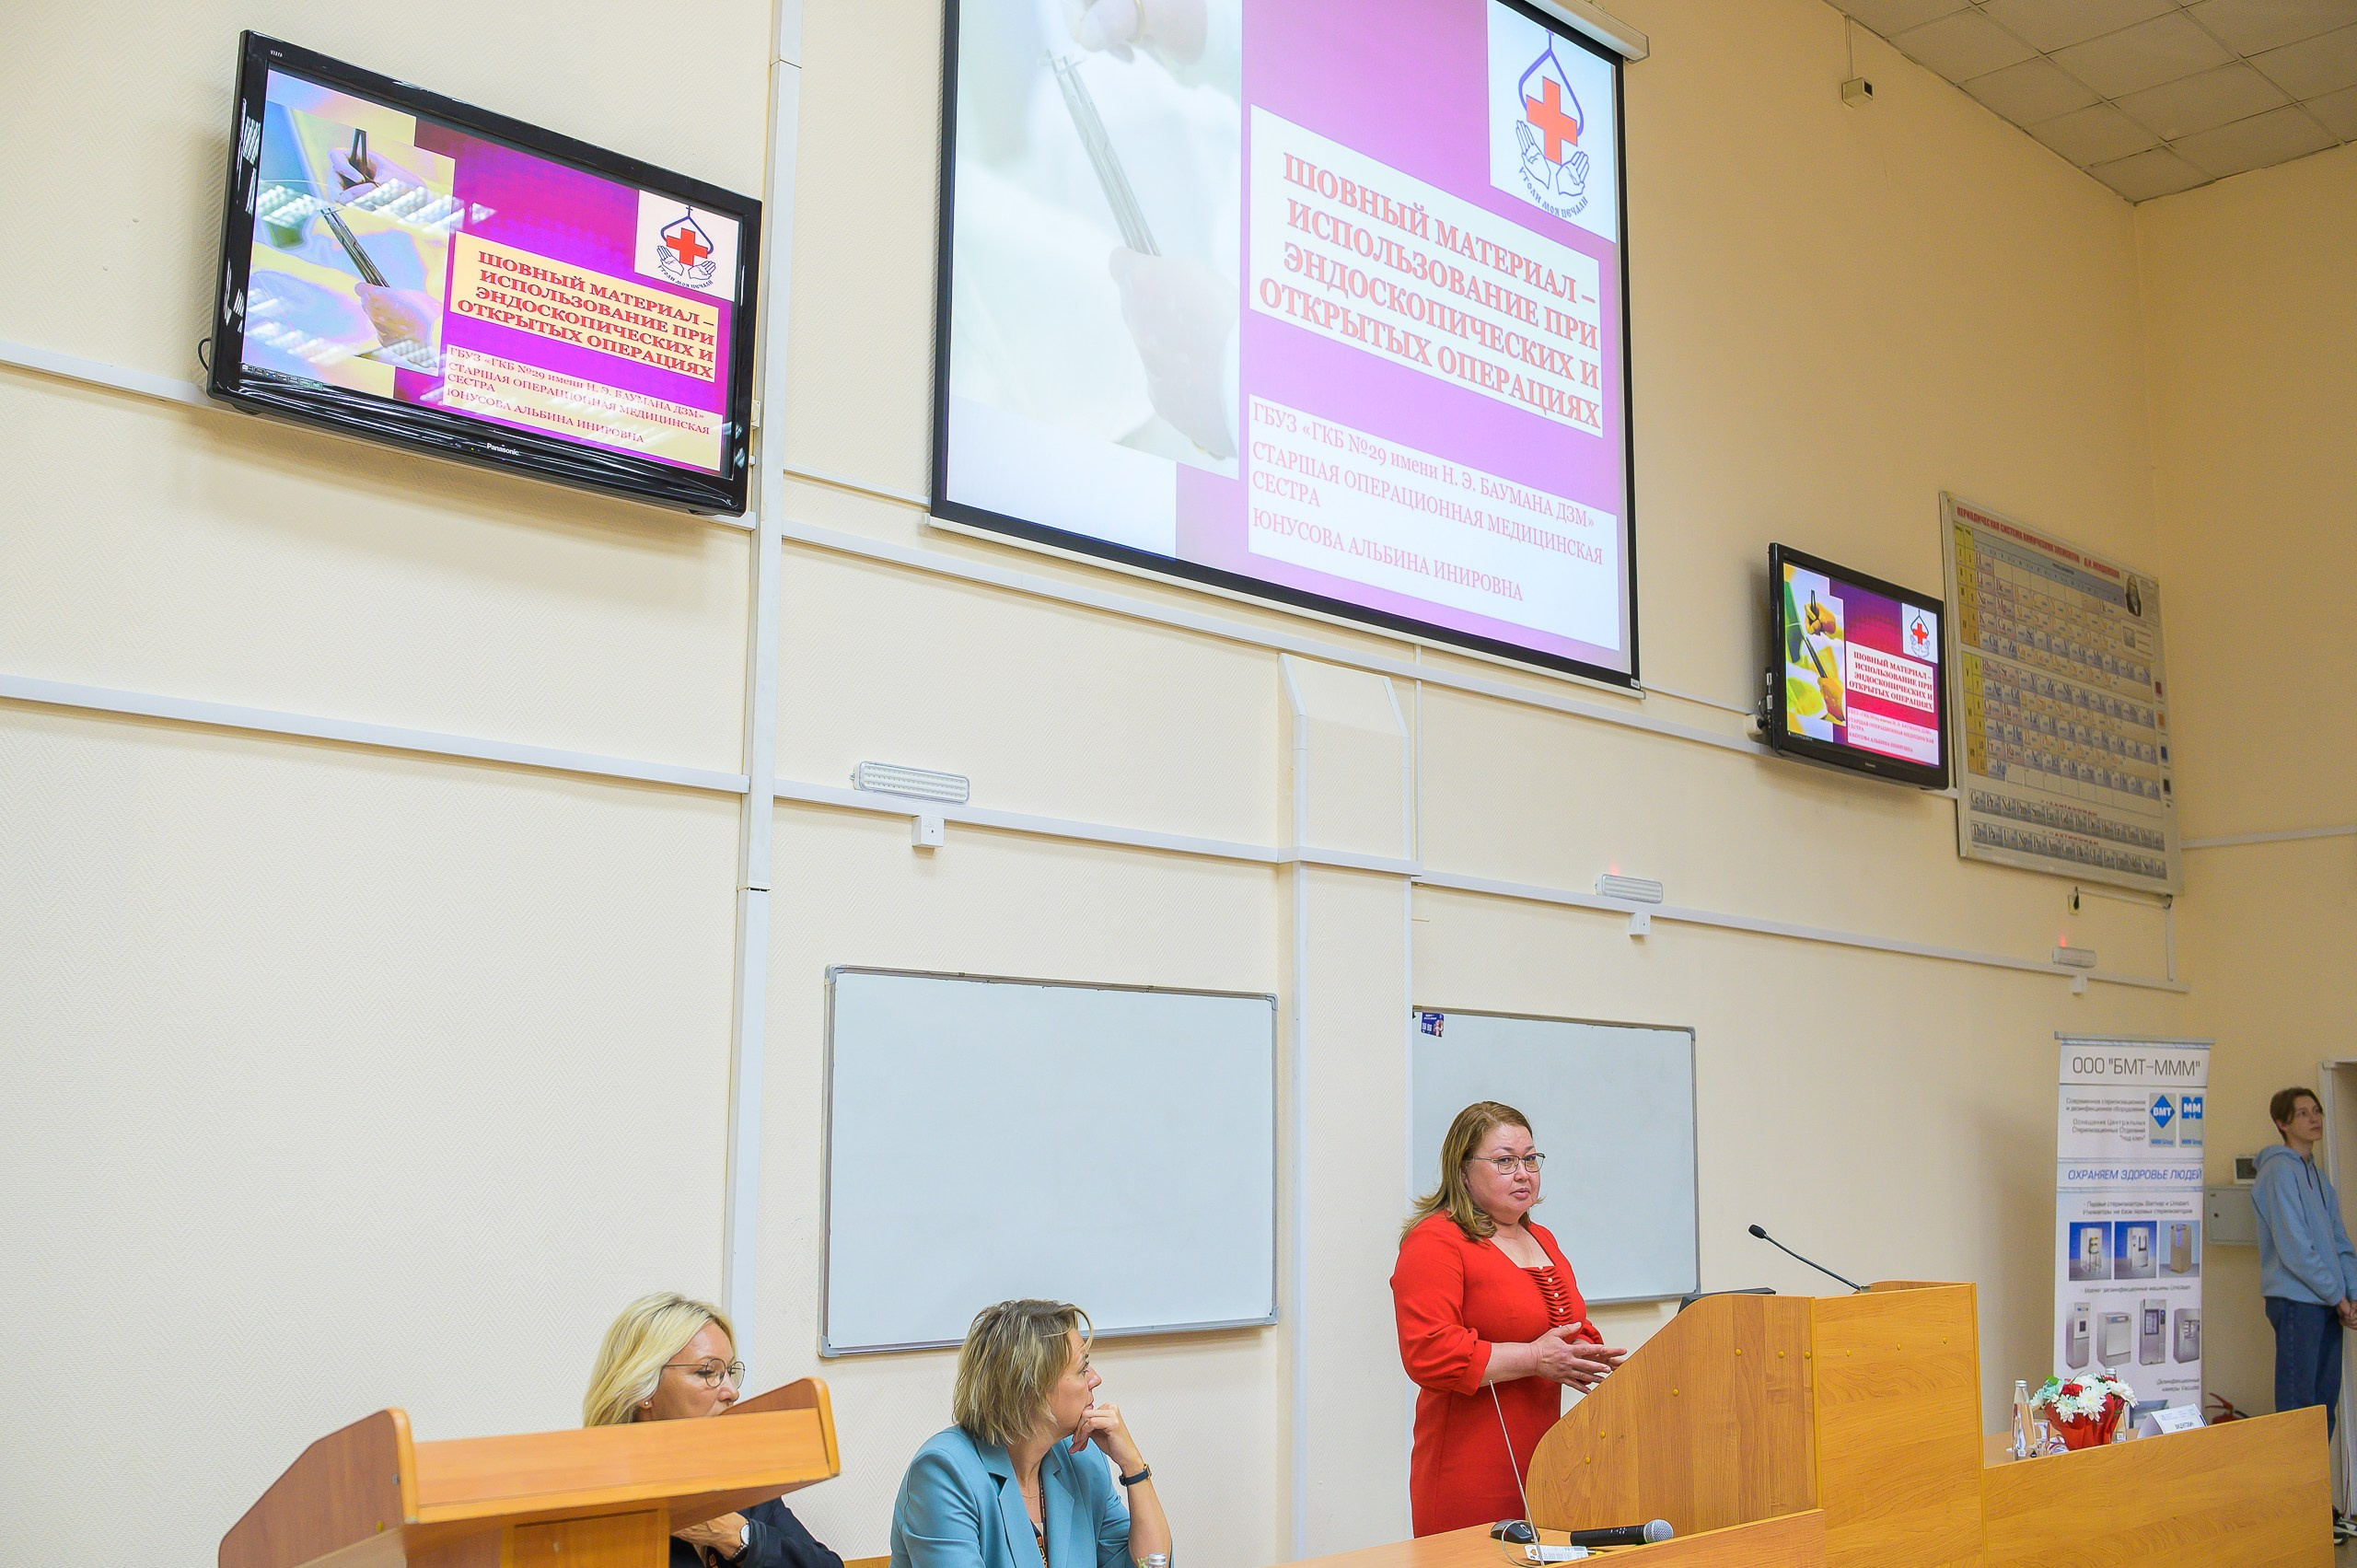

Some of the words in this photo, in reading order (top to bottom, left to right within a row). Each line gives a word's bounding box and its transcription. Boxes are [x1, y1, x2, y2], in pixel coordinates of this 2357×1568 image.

[1283, 152, 1428, 239] ШОВНЫЙ
[1435, 217, 1577, 304] МАТЕРИАЛ
[478, 251, 585, 292] ШОВНЫЙ
[589, 283, 700, 324] МАТЕРИАЛ
[480, 270, 668, 332] ИСПОЛЬЗОВАНИЕ
[673, 324, 714, 346] ПРИ
[1287, 198, 1538, 328] ИСПОЛЬЗОВАНИЕ
[1544, 307, 1598, 351] ПРИ
[458, 299, 583, 343] ОТКРЫТЫХ
[586, 335, 714, 379] ОПЕРАЦИЯХ
[476, 286, 694, 357] ЭНДОСКОПИЧЕСКИХ
[699, 347, 714, 363] И
[1260, 277, 1433, 366] ОТКРЫТЫХ
[1437, 345, 1601, 429] ОПЕРАЦИЯХ
[1284, 241, 1575, 380] ЭНДОСКОПИЧЕСКИХ
[1580, 361, 1598, 392] И
[447, 373, 495, 392] СЕСТРА
[447, 388, 511, 412] ЮНУСОВА
[514, 404, 574, 426] АЛЬБИНА
[577, 418, 644, 443] ИНИРОВНА
[448, 362, 510, 385] СТАРШАЯ
[513, 377, 616, 412] ОПЕРАЦИОННАЯ
[620, 403, 710, 435] МЕДИЦИНСКАЯ
[450, 347, 481, 363] ГБУЗ
[483, 356, 515, 371] «ГКБ
[517, 364, 545, 380] №29
[548, 374, 584, 389] имени
[601, 385, 612, 398] Э.
[614, 389, 671, 412] БАУМАНА
[673, 403, 704, 420] ДЗМ»
[487, 443, 520, 456] Panasonic
[1252, 402, 1298, 433] ГБУЗ
[1303, 421, 1344, 448] «ГКБ
[1349, 436, 1387, 466] №29
[1390, 449, 1438, 480] имени
[1443, 467, 1458, 486] Н.
[1462, 472, 1476, 492] Э.
[1480, 478, 1553, 517] БАУМАНА
[1556, 501, 1595, 528] ДЗМ»
[1253, 470, 1320, 507] СЕСТРА
[1253, 441, 1340, 485] СТАРШАЯ
[1344, 469, 1483, 528] ОПЕРАЦИОННАЯ
[1488, 514, 1603, 565] МЕДИЦИНСКАЯ
[1253, 506, 1344, 552] ЮНУСОВА
[1348, 537, 1430, 575] АЛЬБИНА
[1434, 560, 1524, 602] ИНИРОВНА
[1849, 680, 1889, 699] ОТКРЫТЫХ
[1890, 692, 1933, 710] ОПЕРАЦИЯХ
[1853, 651, 1888, 668] ШОВНЫЙ
[1890, 661, 1926, 679] МАТЕРИАЛ
[1854, 671, 1926, 700] ЭНДОСКОПИЧЕСКИХ
[1855, 661, 1917, 688] ИСПОЛЬЗОВАНИЕ
[1918, 679, 1933, 691] ПРИ
[2073, 1056, 2105, 1074] ООО
[2068, 1168, 2119, 1180] ОХРАНЯЕМ
[2121, 1168, 2168, 1181] ЗДОРОВЬЕ
[2170, 1168, 2202, 1181] ЛЮДЕЙ
